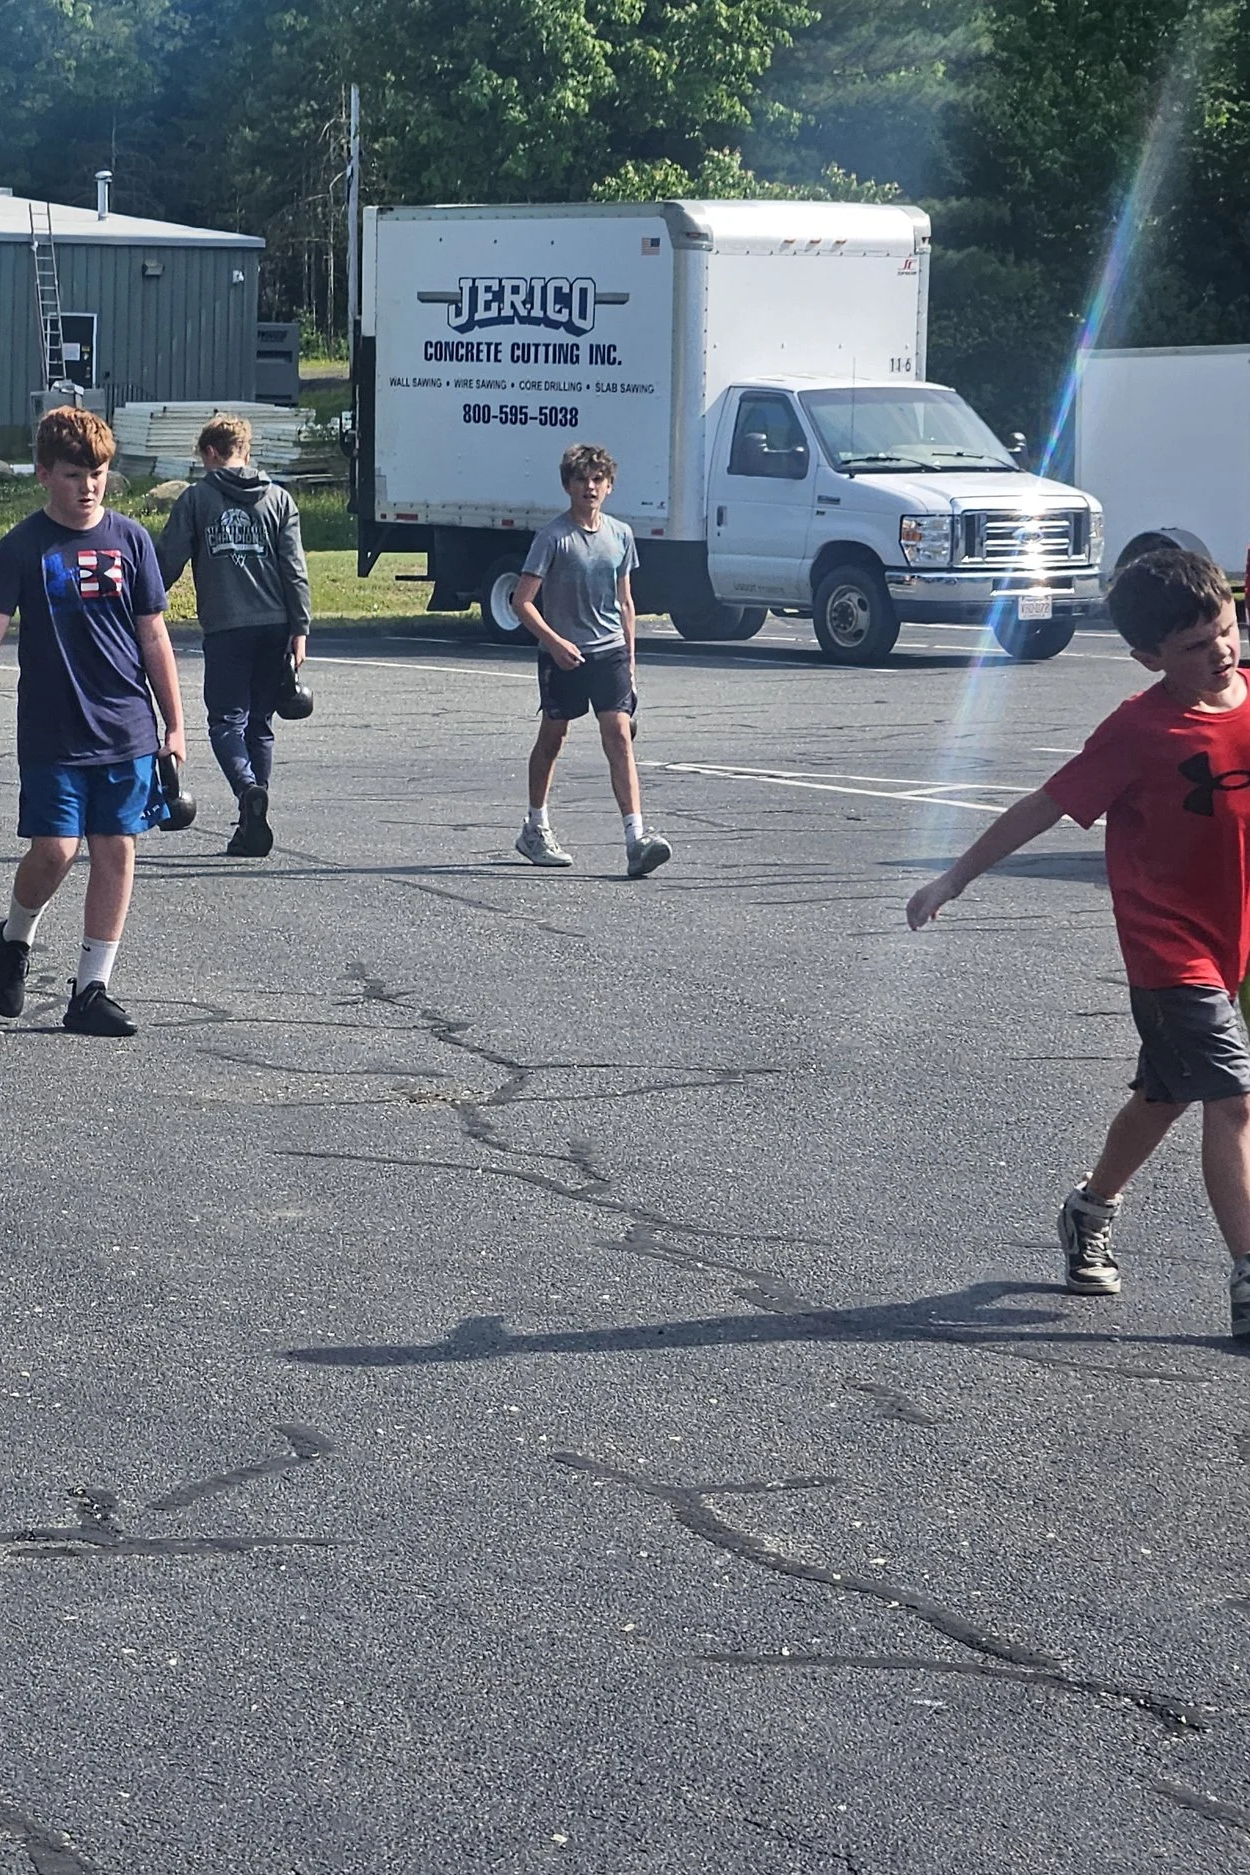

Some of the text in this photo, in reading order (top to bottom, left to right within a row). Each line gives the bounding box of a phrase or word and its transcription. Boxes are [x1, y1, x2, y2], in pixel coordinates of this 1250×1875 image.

[447, 277, 596, 337] JERICO
[423, 340, 623, 366] CONCRETE CUTTING INC.
[890, 357, 912, 373] 116
[389, 377, 655, 394] WALL SAWING WIRE SAWING CORE DRILLING SLAB SAWING
[462, 403, 579, 427] 800-595-5038
